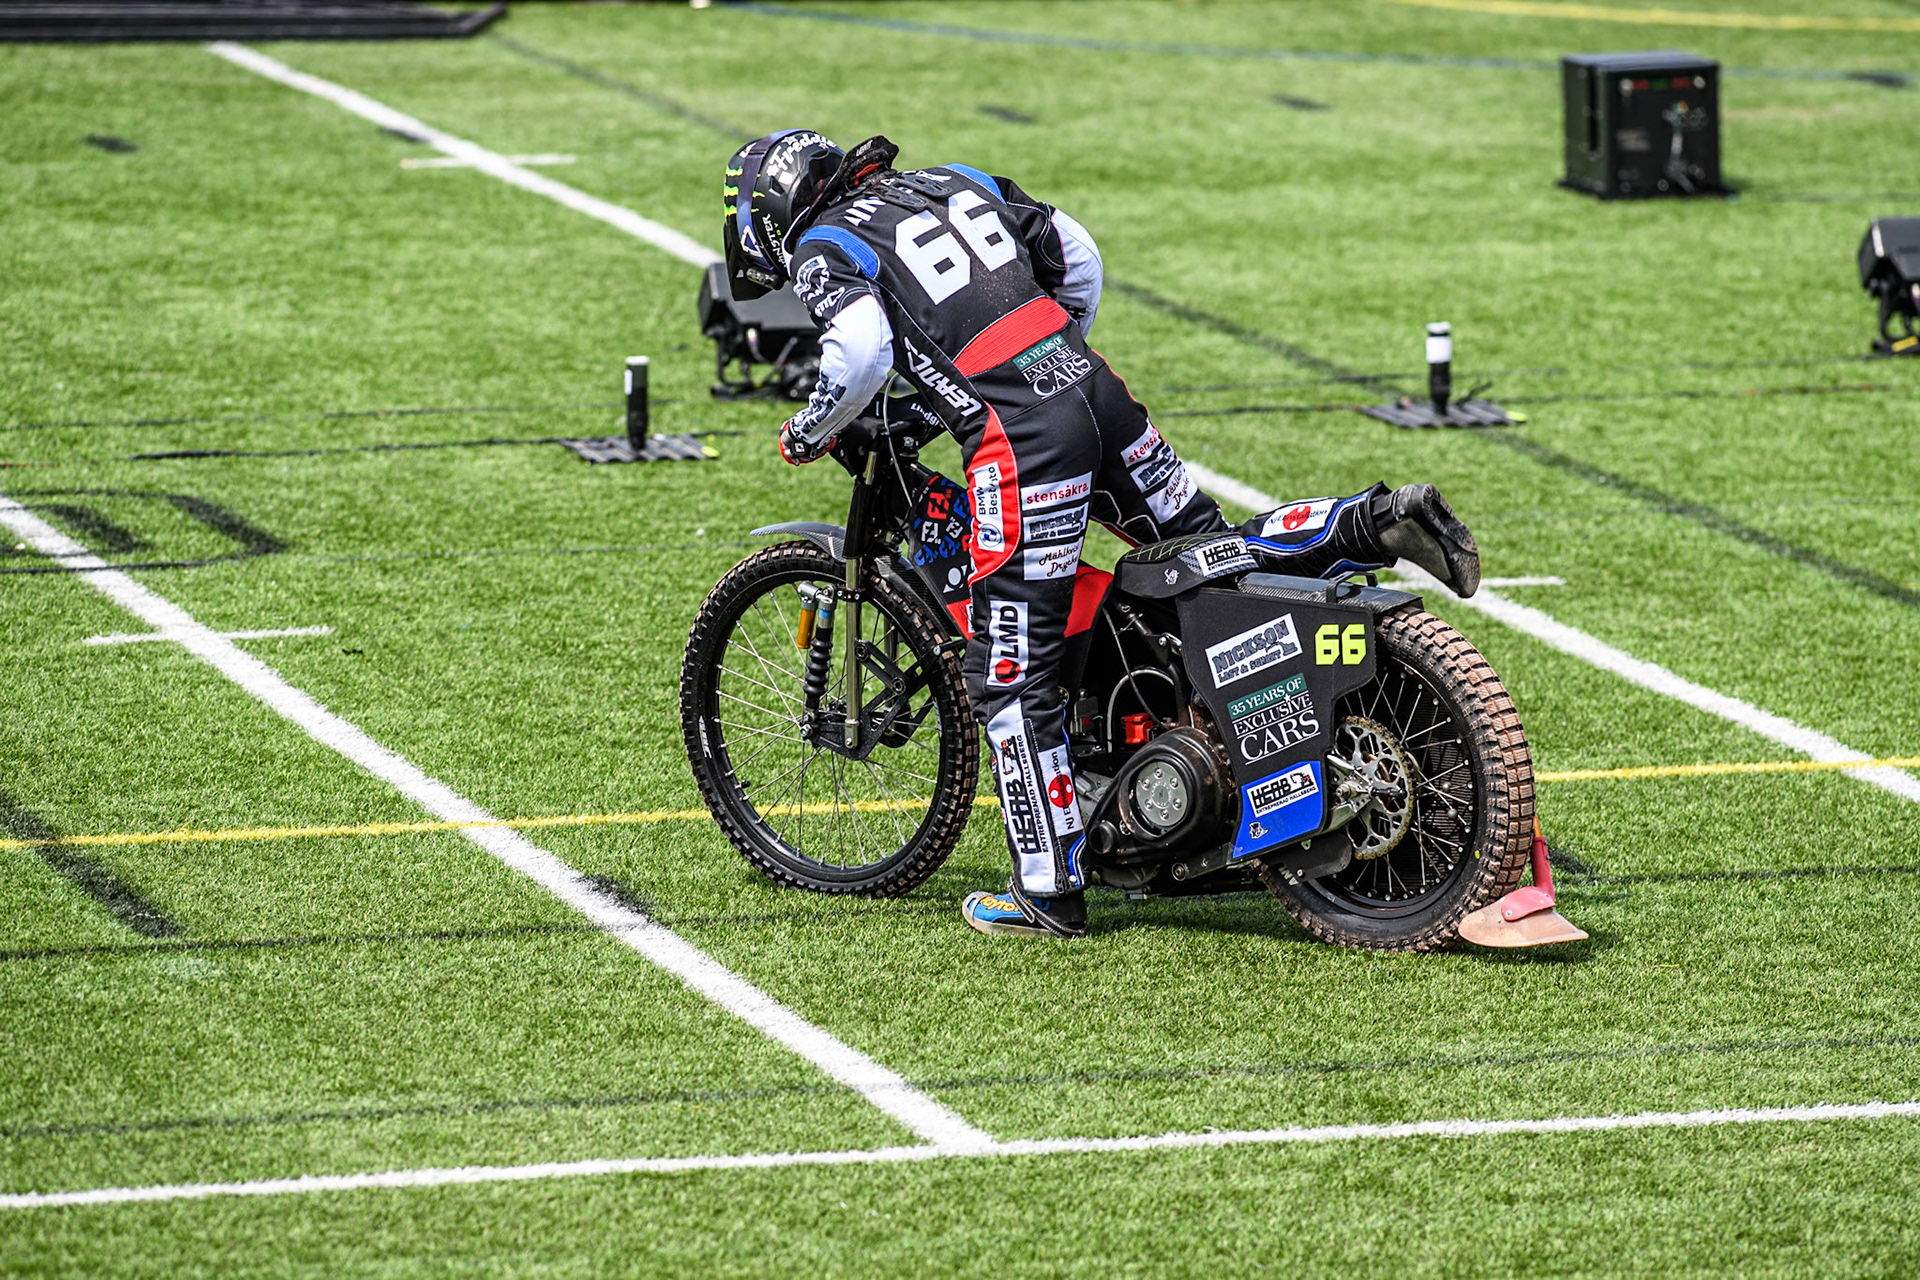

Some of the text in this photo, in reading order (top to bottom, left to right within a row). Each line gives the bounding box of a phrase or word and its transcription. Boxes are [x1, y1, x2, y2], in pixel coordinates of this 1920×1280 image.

[894, 189, 1018, 306] 66
[1017, 335, 1063, 367] 35 YEARS OF
[1033, 354, 1091, 396] CARS
[976, 486, 986, 515] BMW
[1026, 482, 1088, 505] stensåkra
[999, 605, 1019, 658] LMD
[1211, 619, 1290, 674] NICKSON
[1314, 623, 1367, 666] 66
[1240, 664, 1249, 674] &
[1231, 677, 1302, 716] 35 YEARS OF
[1233, 693, 1313, 736] EXCLUSIVE
[1240, 709, 1320, 761] CARS
[1006, 778, 1040, 853] HEAB
[1065, 817, 1075, 830] NJ
